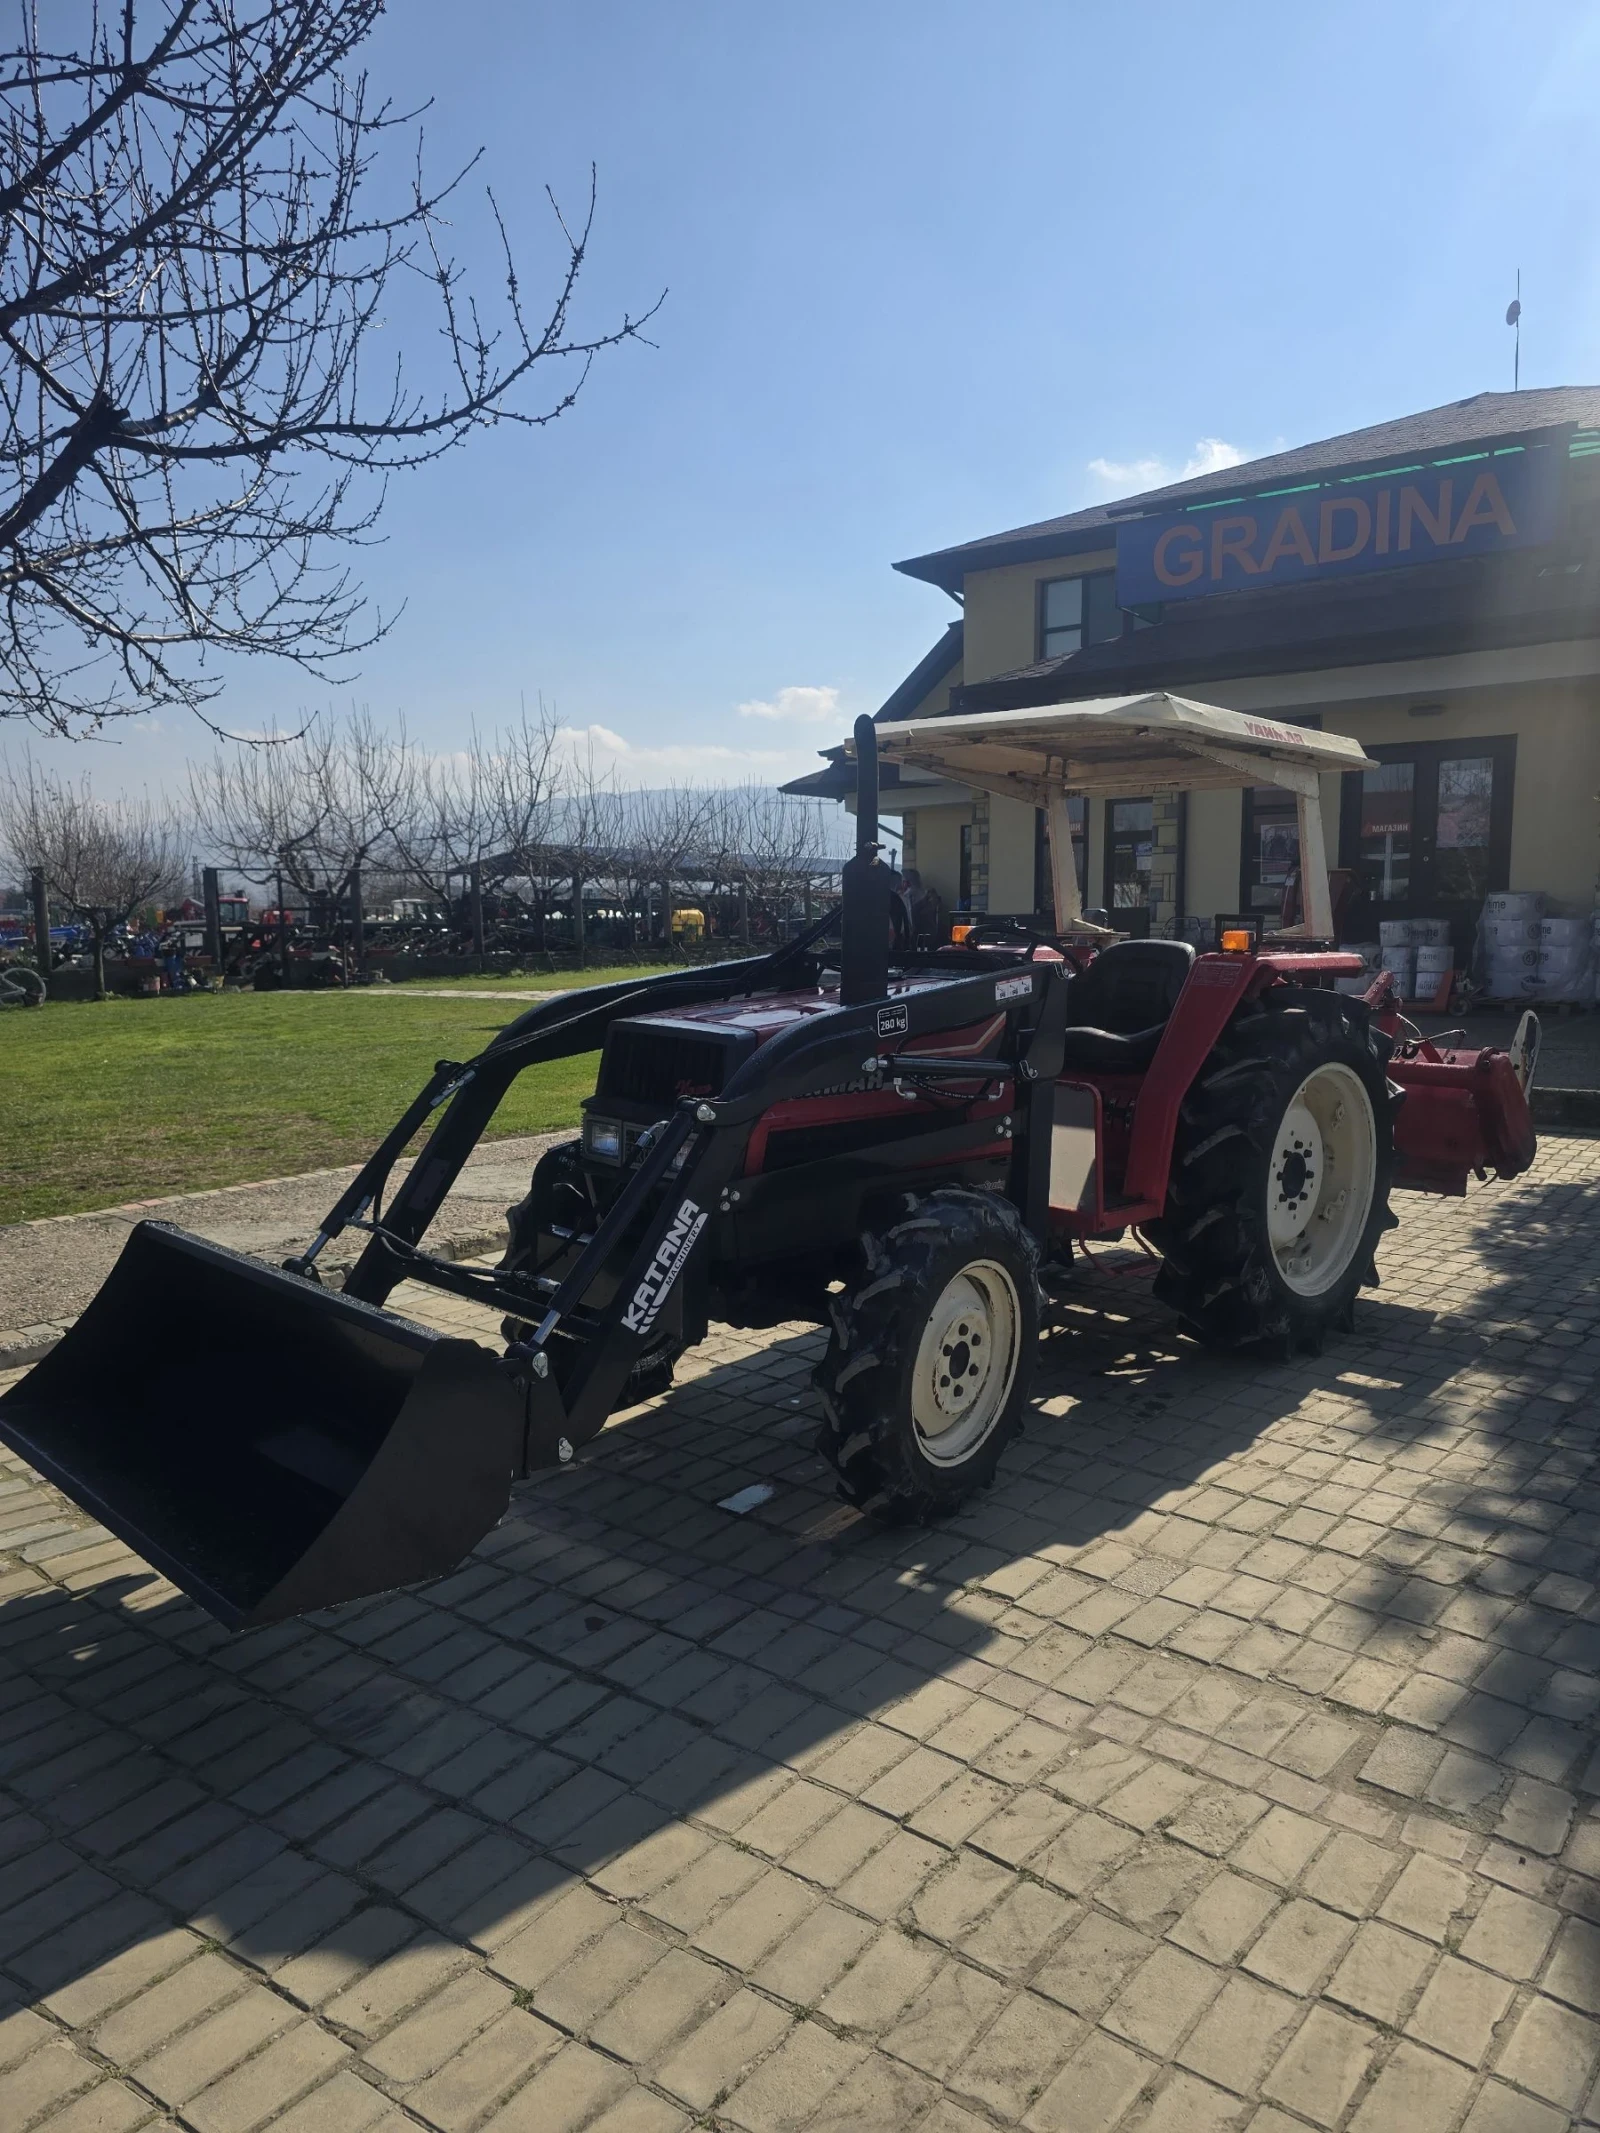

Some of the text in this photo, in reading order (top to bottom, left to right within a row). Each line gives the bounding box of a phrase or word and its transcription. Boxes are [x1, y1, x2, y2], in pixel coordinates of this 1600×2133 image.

[1152, 472, 1517, 586] GRADINA
[1372, 823, 1409, 833] МАГАЗИН
[880, 1017, 906, 1031] 280 kg
[620, 1199, 700, 1332] KATANA
[665, 1222, 701, 1287] MACHINERY
